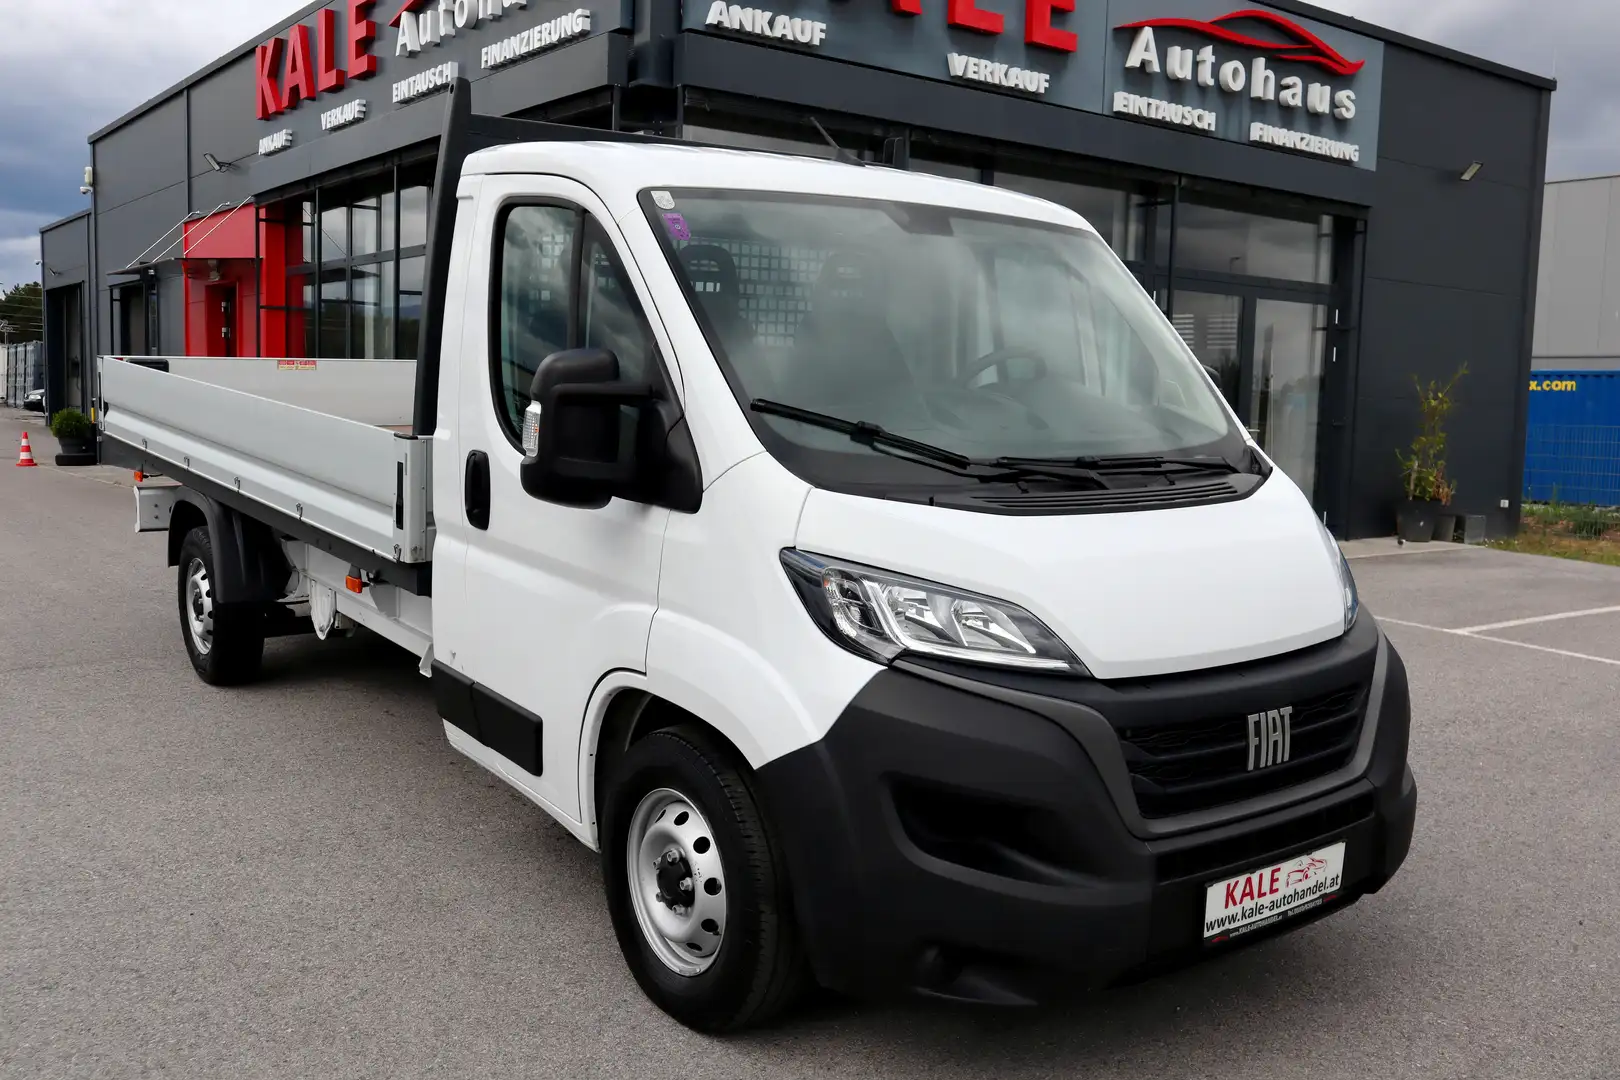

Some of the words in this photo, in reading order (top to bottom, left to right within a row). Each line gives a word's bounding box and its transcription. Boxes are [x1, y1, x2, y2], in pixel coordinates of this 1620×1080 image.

[481, 9, 591, 69] FINANZIERUNG
[705, 0, 826, 46] ANKAUF
[255, 0, 377, 120] KALE
[392, 61, 458, 103] EINTAUSCH
[947, 53, 1050, 94] VERKAUF
[1125, 26, 1356, 120] Autohaus
[321, 99, 366, 130] VERKAUF
[1113, 91, 1216, 131] EINTAUSCH
[1250, 122, 1360, 162] FINANZIERUNG
[1247, 706, 1293, 771] FIAT
[1205, 874, 1340, 933] www.kale-autohandel.at
[1224, 867, 1281, 909] KALE
